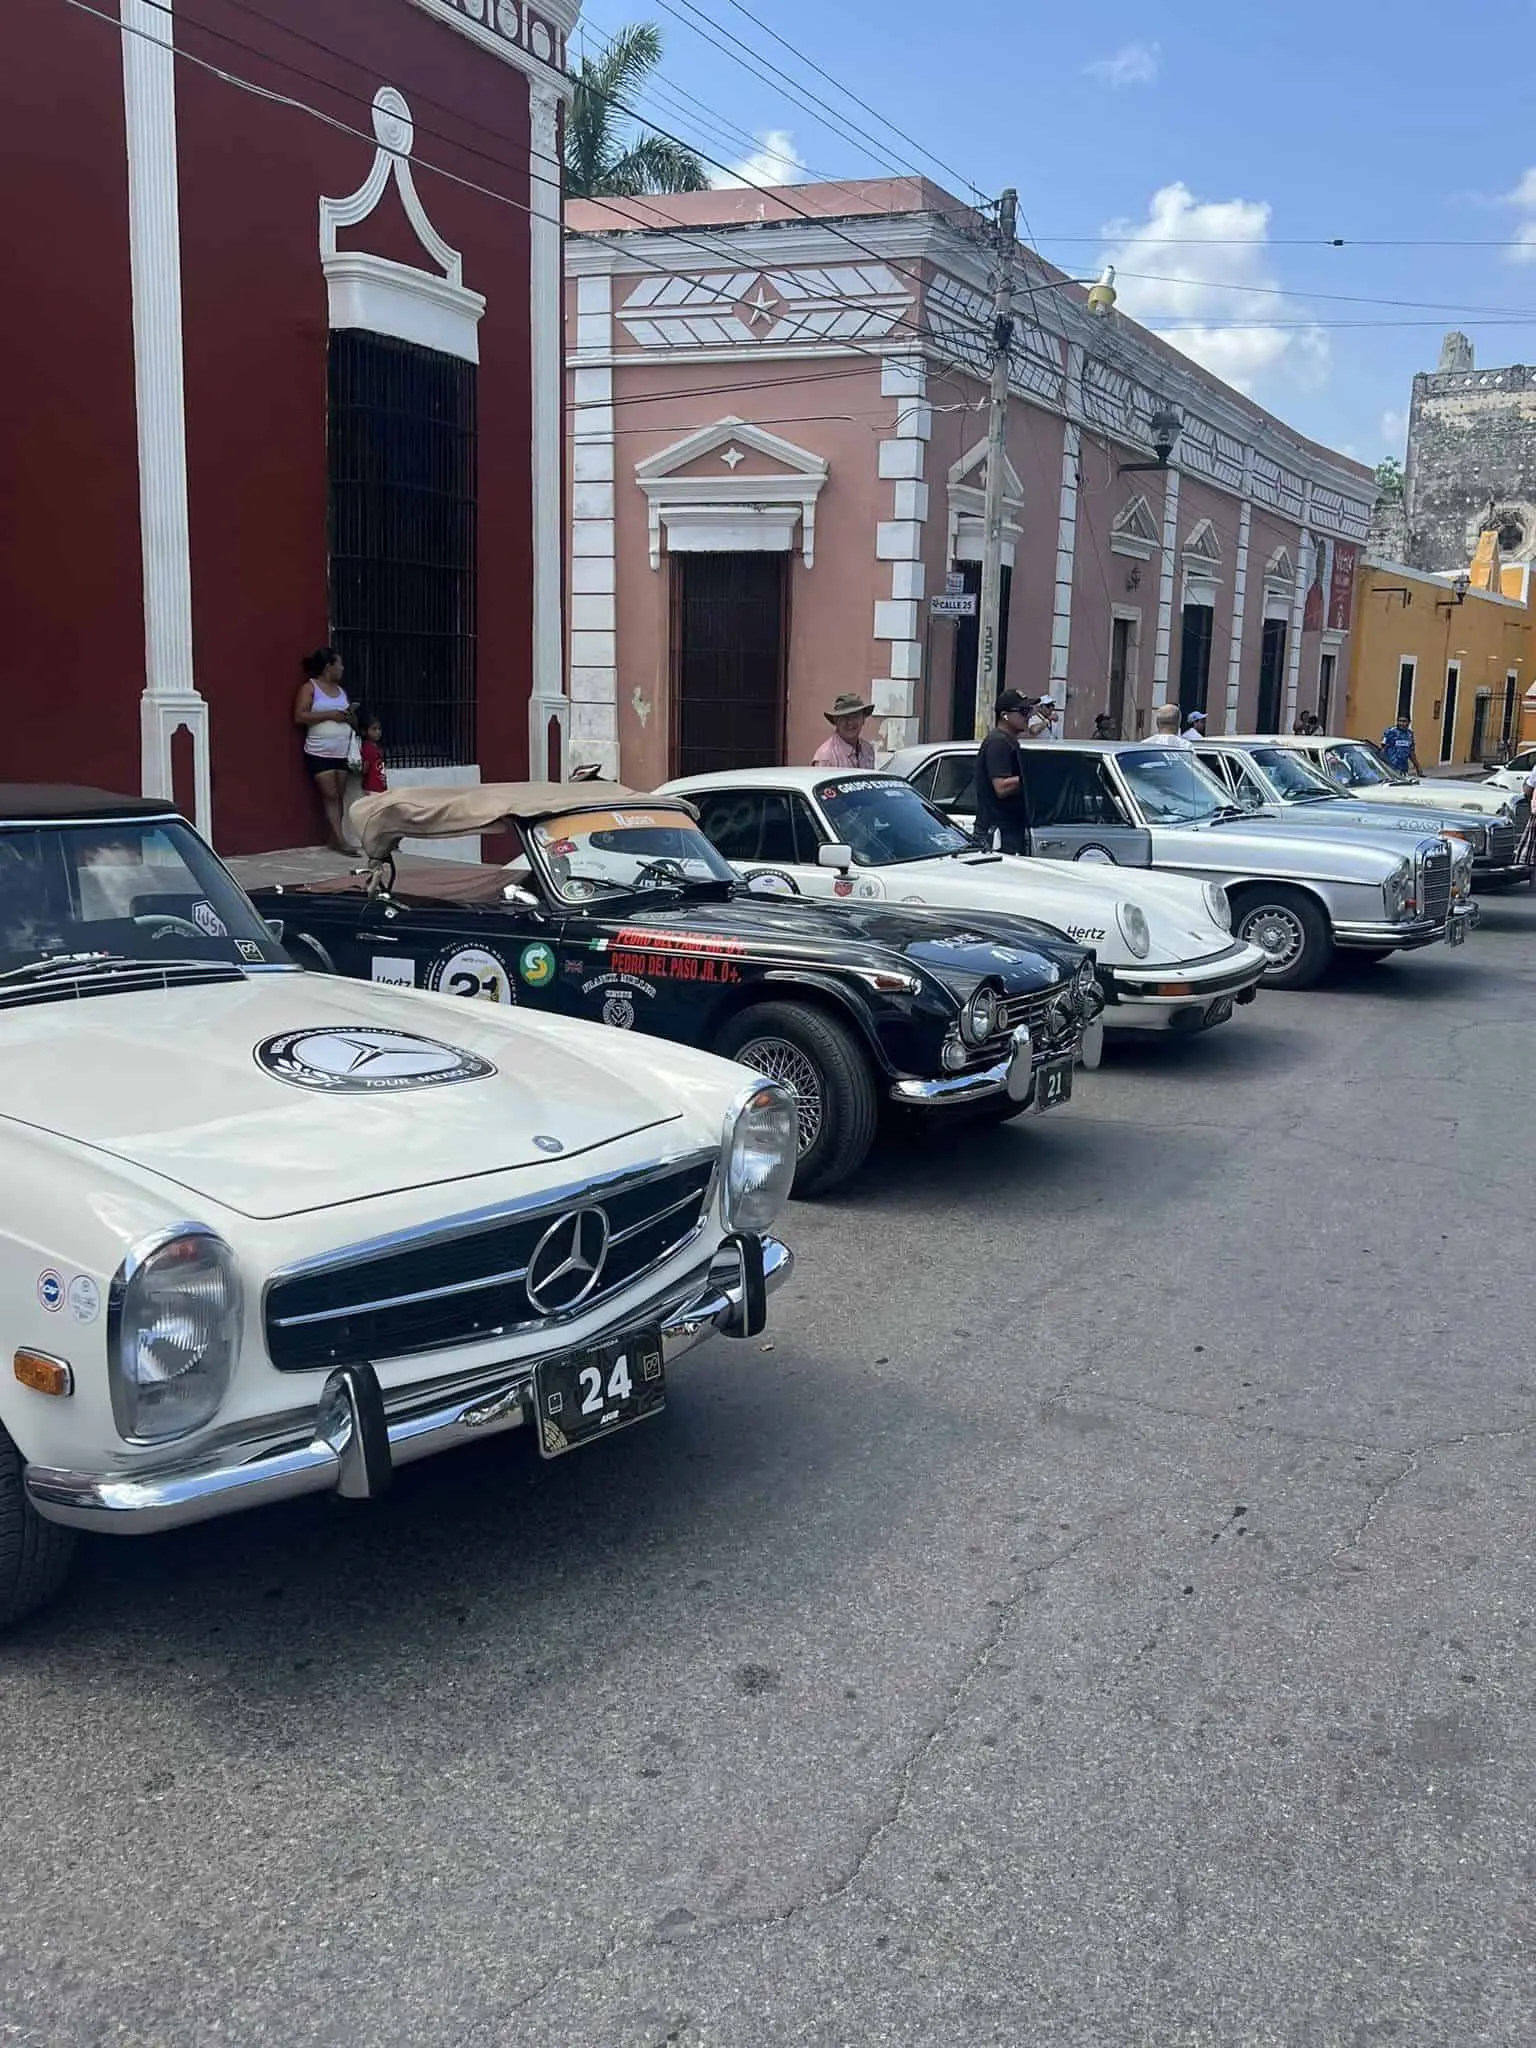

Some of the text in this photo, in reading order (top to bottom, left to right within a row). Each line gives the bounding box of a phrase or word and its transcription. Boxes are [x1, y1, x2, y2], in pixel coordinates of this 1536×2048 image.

[940, 599, 972, 609] CALLE 25
[1067, 925, 1106, 940] Hertz
[611, 952, 646, 975] PEDRO
[648, 955, 668, 976] DEL
[671, 957, 698, 980] PASO
[450, 972, 499, 1002] 21
[365, 1079, 411, 1087] TOUR
[1047, 1071, 1061, 1098] 21
[579, 1354, 632, 1415] 24
